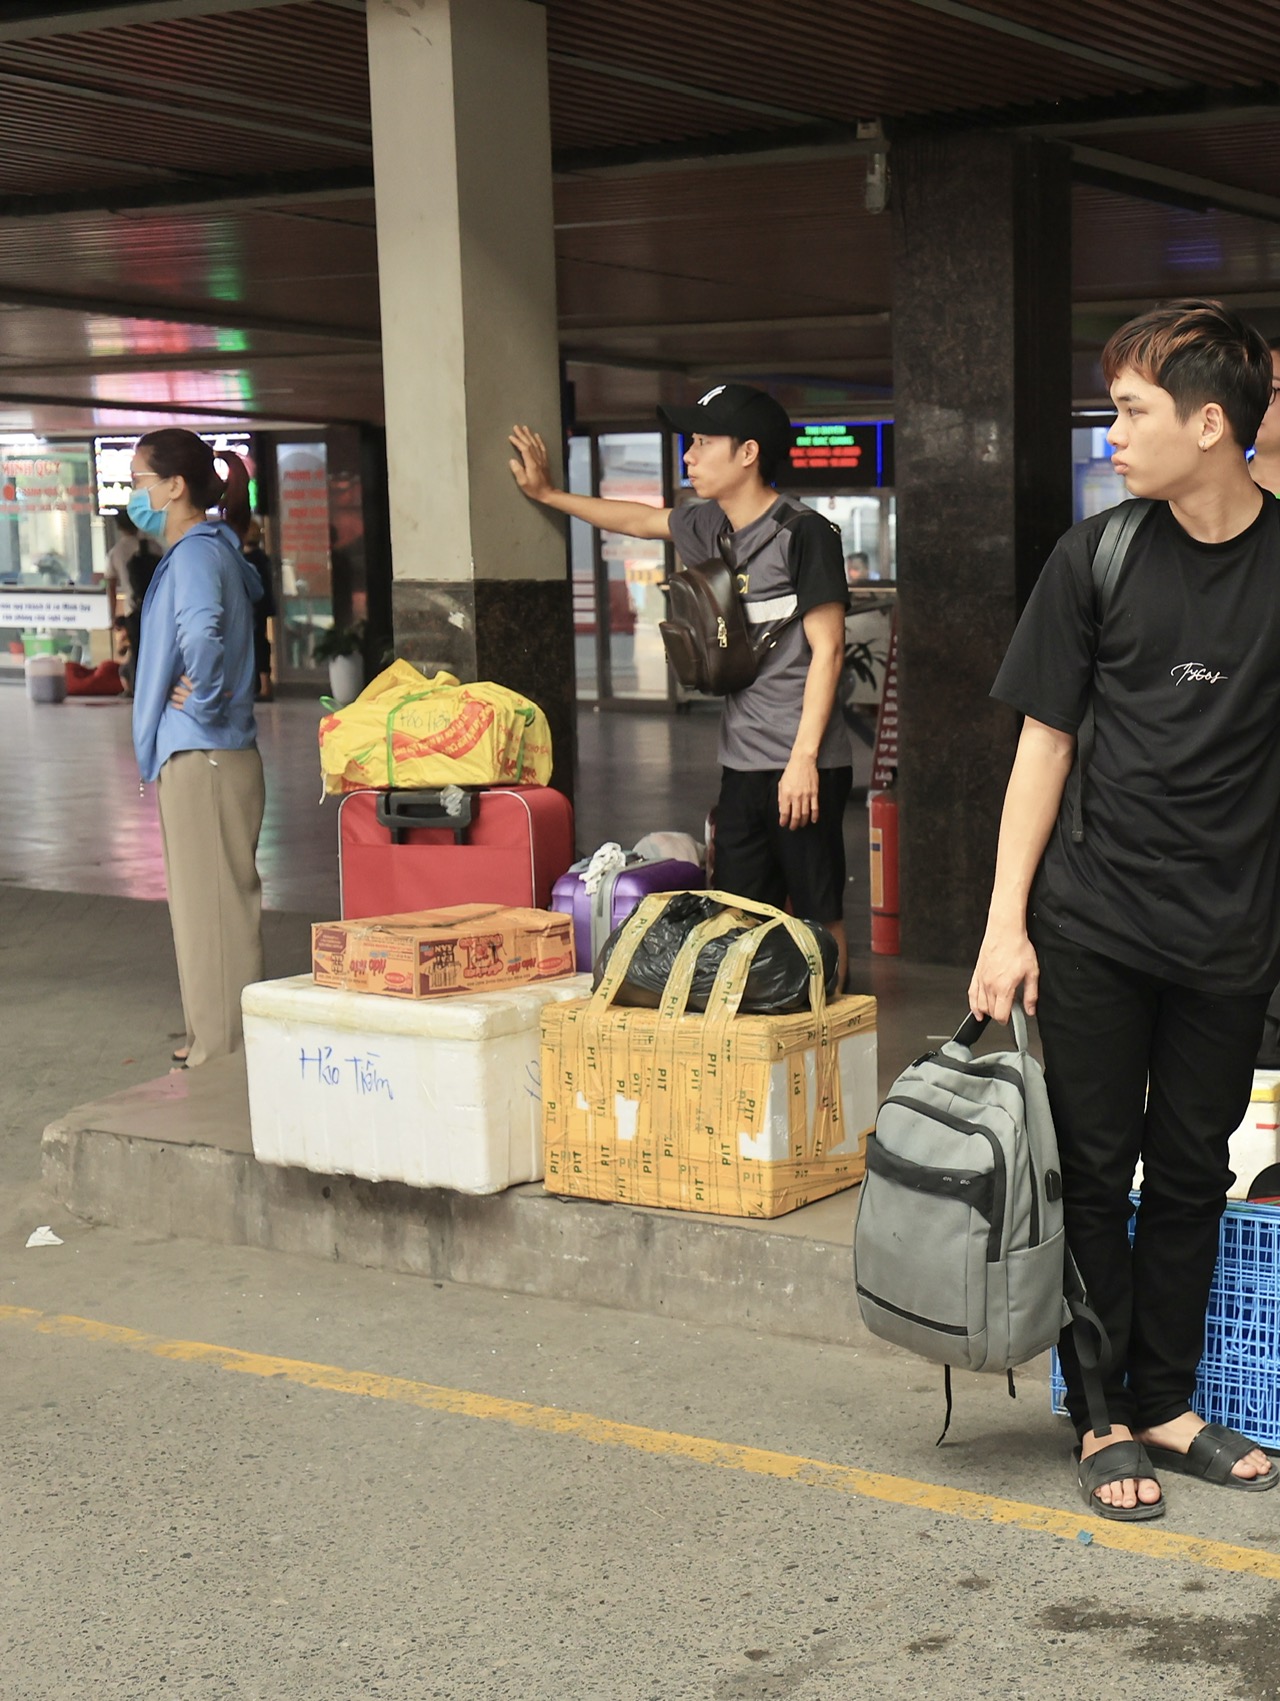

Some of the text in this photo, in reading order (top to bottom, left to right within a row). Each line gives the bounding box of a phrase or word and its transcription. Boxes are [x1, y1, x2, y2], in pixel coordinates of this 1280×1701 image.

[599, 978, 613, 1000] PIT
[568, 1007, 583, 1023] IT
[665, 996, 678, 1019] PIT
[587, 1046, 597, 1070] PIT
[707, 1053, 717, 1077] PIT
[658, 1068, 667, 1091] PIT
[744, 1099, 756, 1122] PIT
[551, 1151, 559, 1174] PIT
[573, 1151, 582, 1173] PIT
[601, 1145, 610, 1166] PIT
[643, 1150, 652, 1174] PIT
[722, 1143, 731, 1166] PIT
[695, 1179, 704, 1201] PIT
[743, 1173, 764, 1184] PIT
